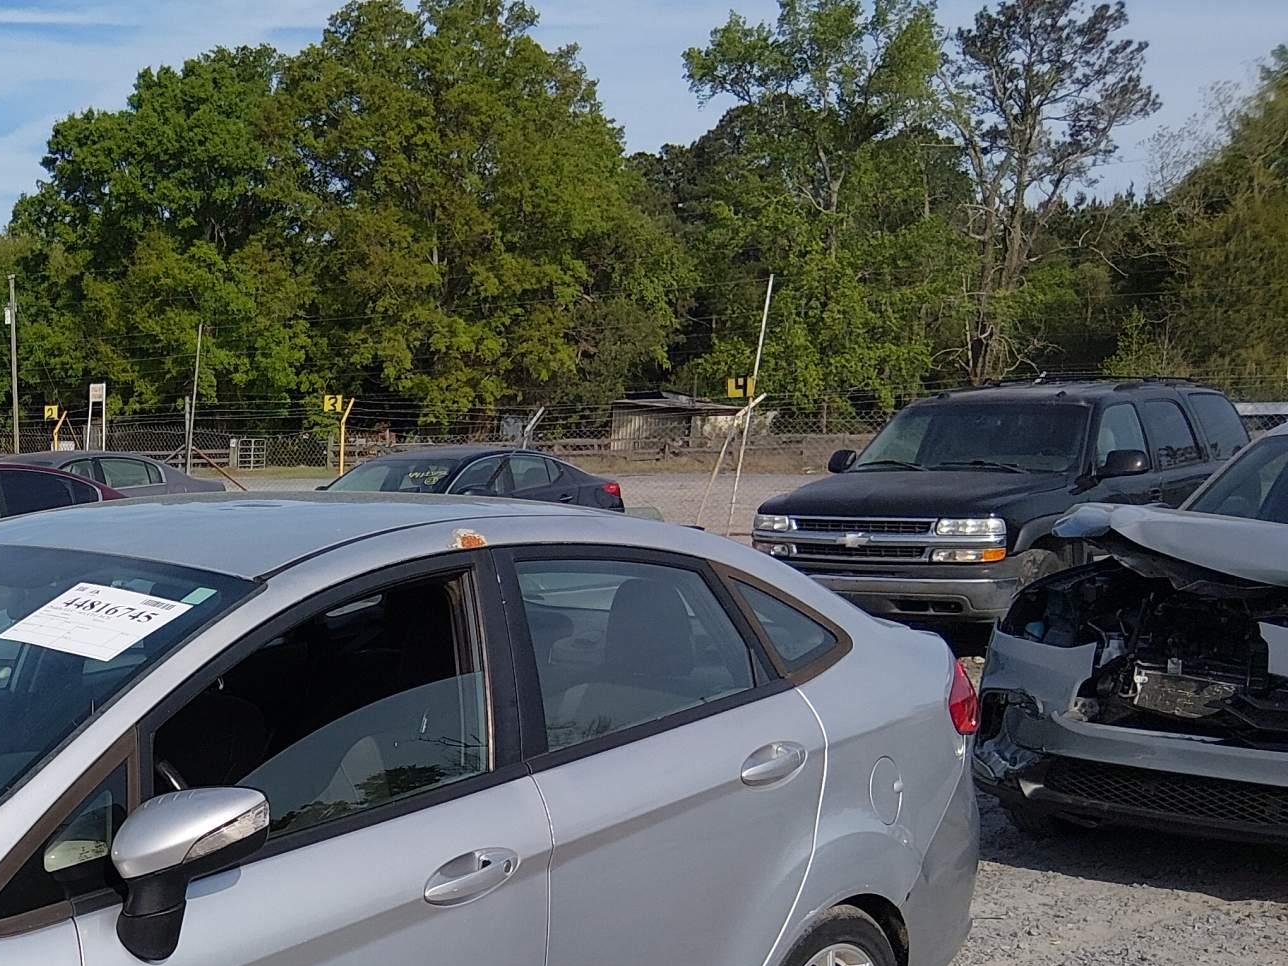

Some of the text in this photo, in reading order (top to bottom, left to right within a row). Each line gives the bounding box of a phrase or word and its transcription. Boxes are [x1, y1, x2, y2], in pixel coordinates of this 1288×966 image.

[734, 375, 748, 398] 4
[327, 396, 338, 412] 3
[63, 597, 160, 625] 44816745
